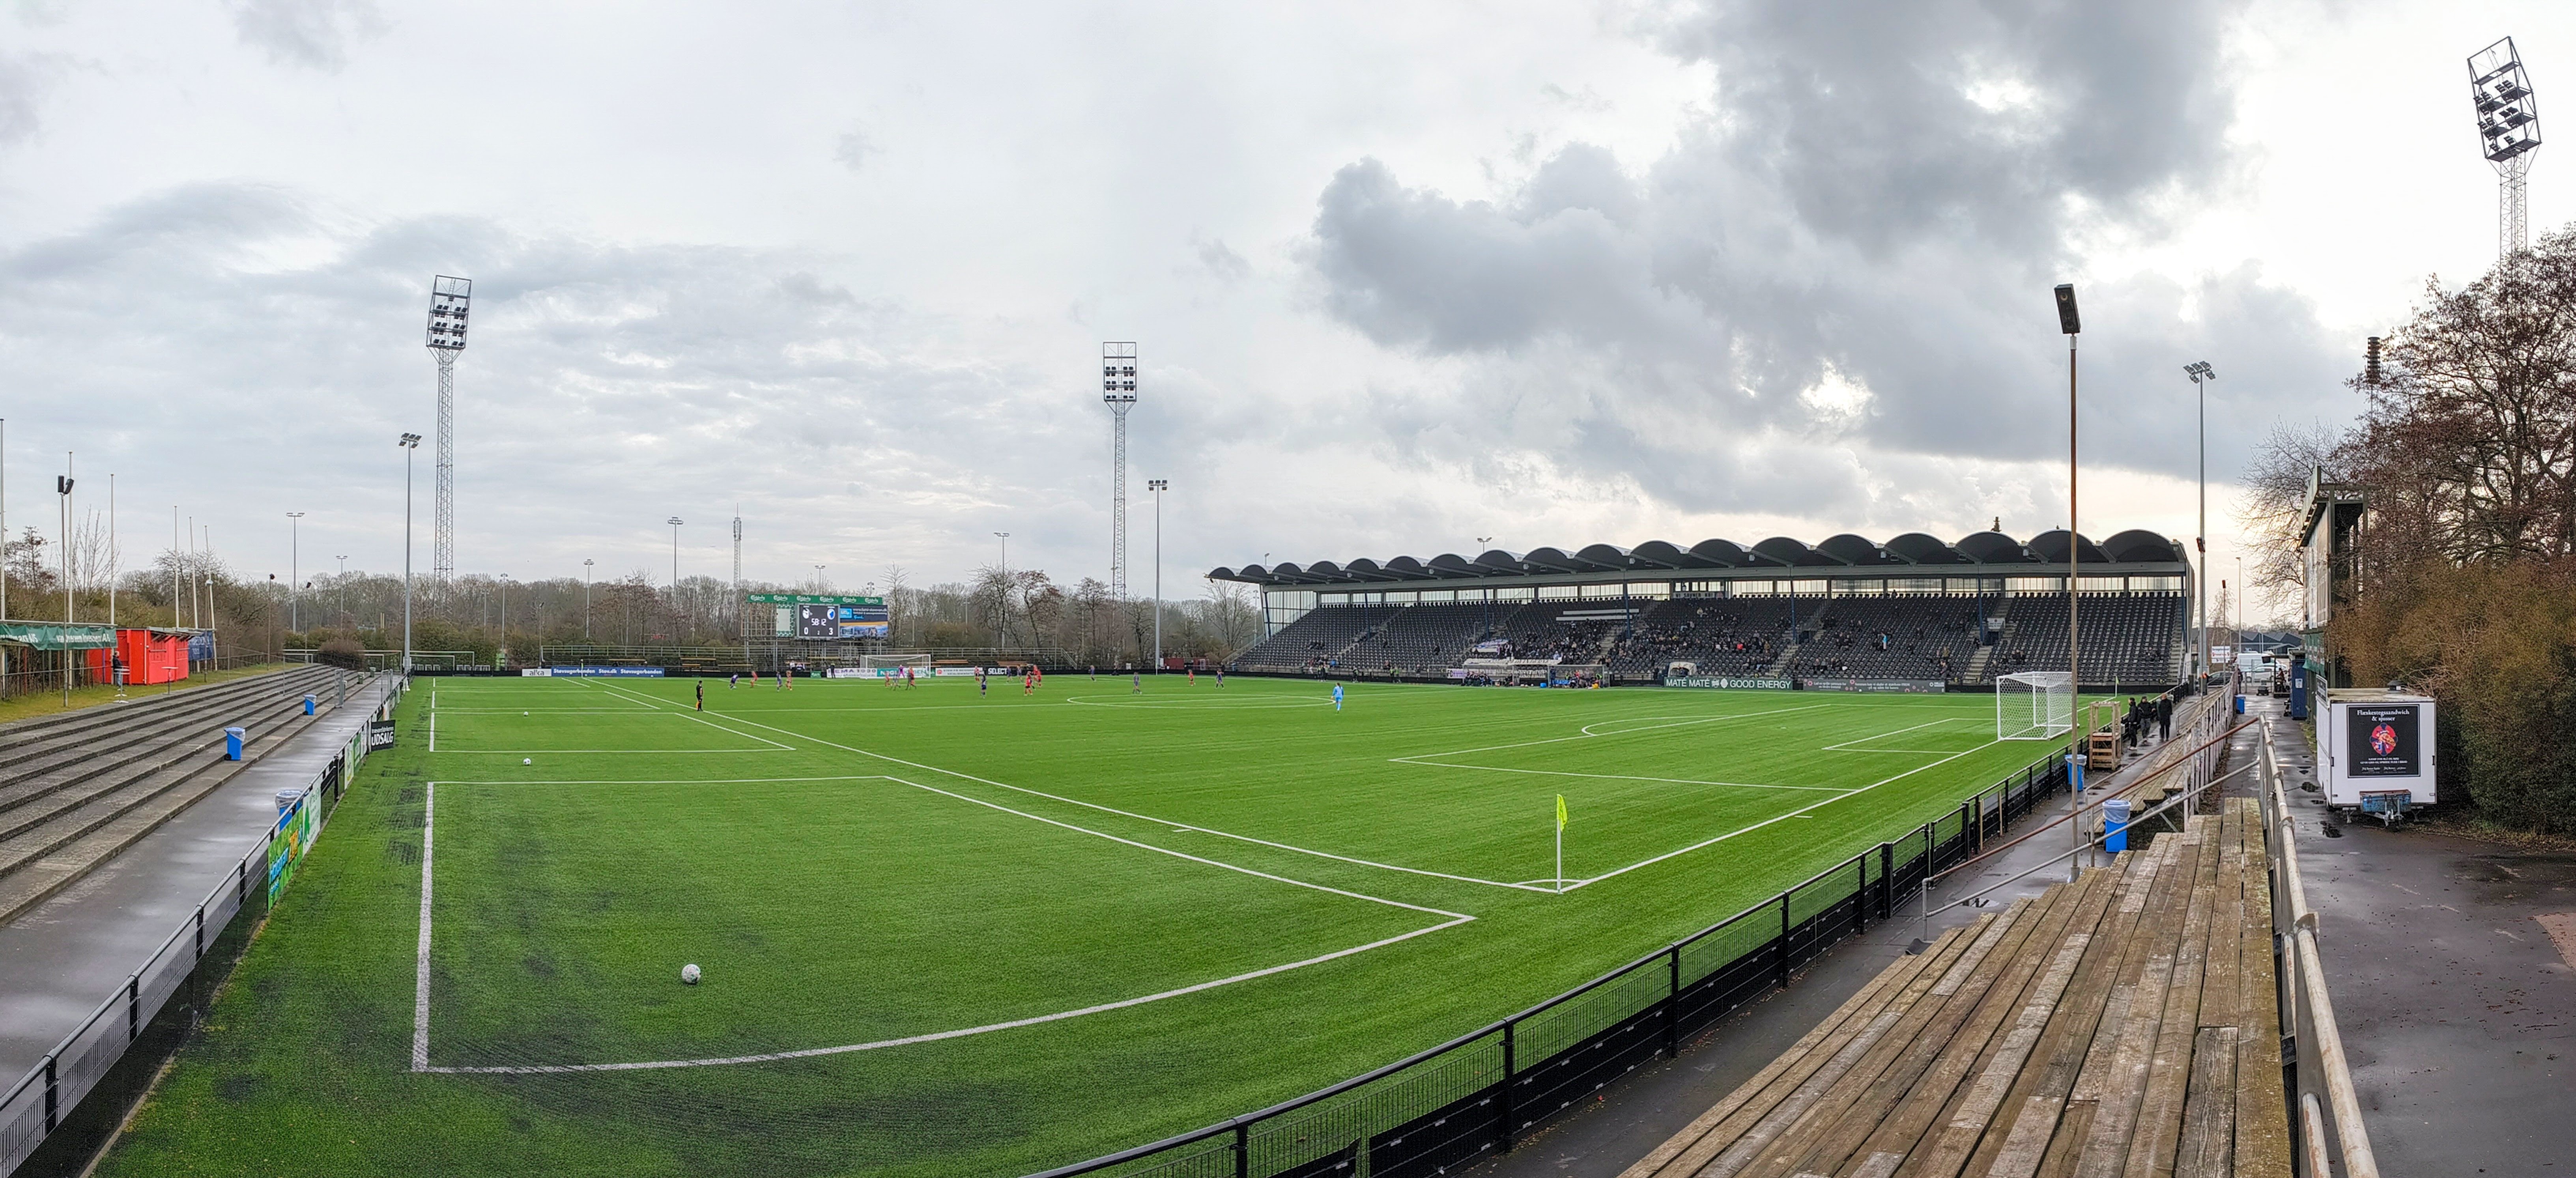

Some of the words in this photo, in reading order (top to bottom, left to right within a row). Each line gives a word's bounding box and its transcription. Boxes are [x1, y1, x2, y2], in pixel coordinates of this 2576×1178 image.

[1666, 678, 1687, 686] MATÉ
[1689, 678, 1710, 687] MATÉ
[1730, 680, 1755, 688] GOOD
[1757, 680, 1791, 689] ENERGY
[372, 731, 394, 746] UDSALG
